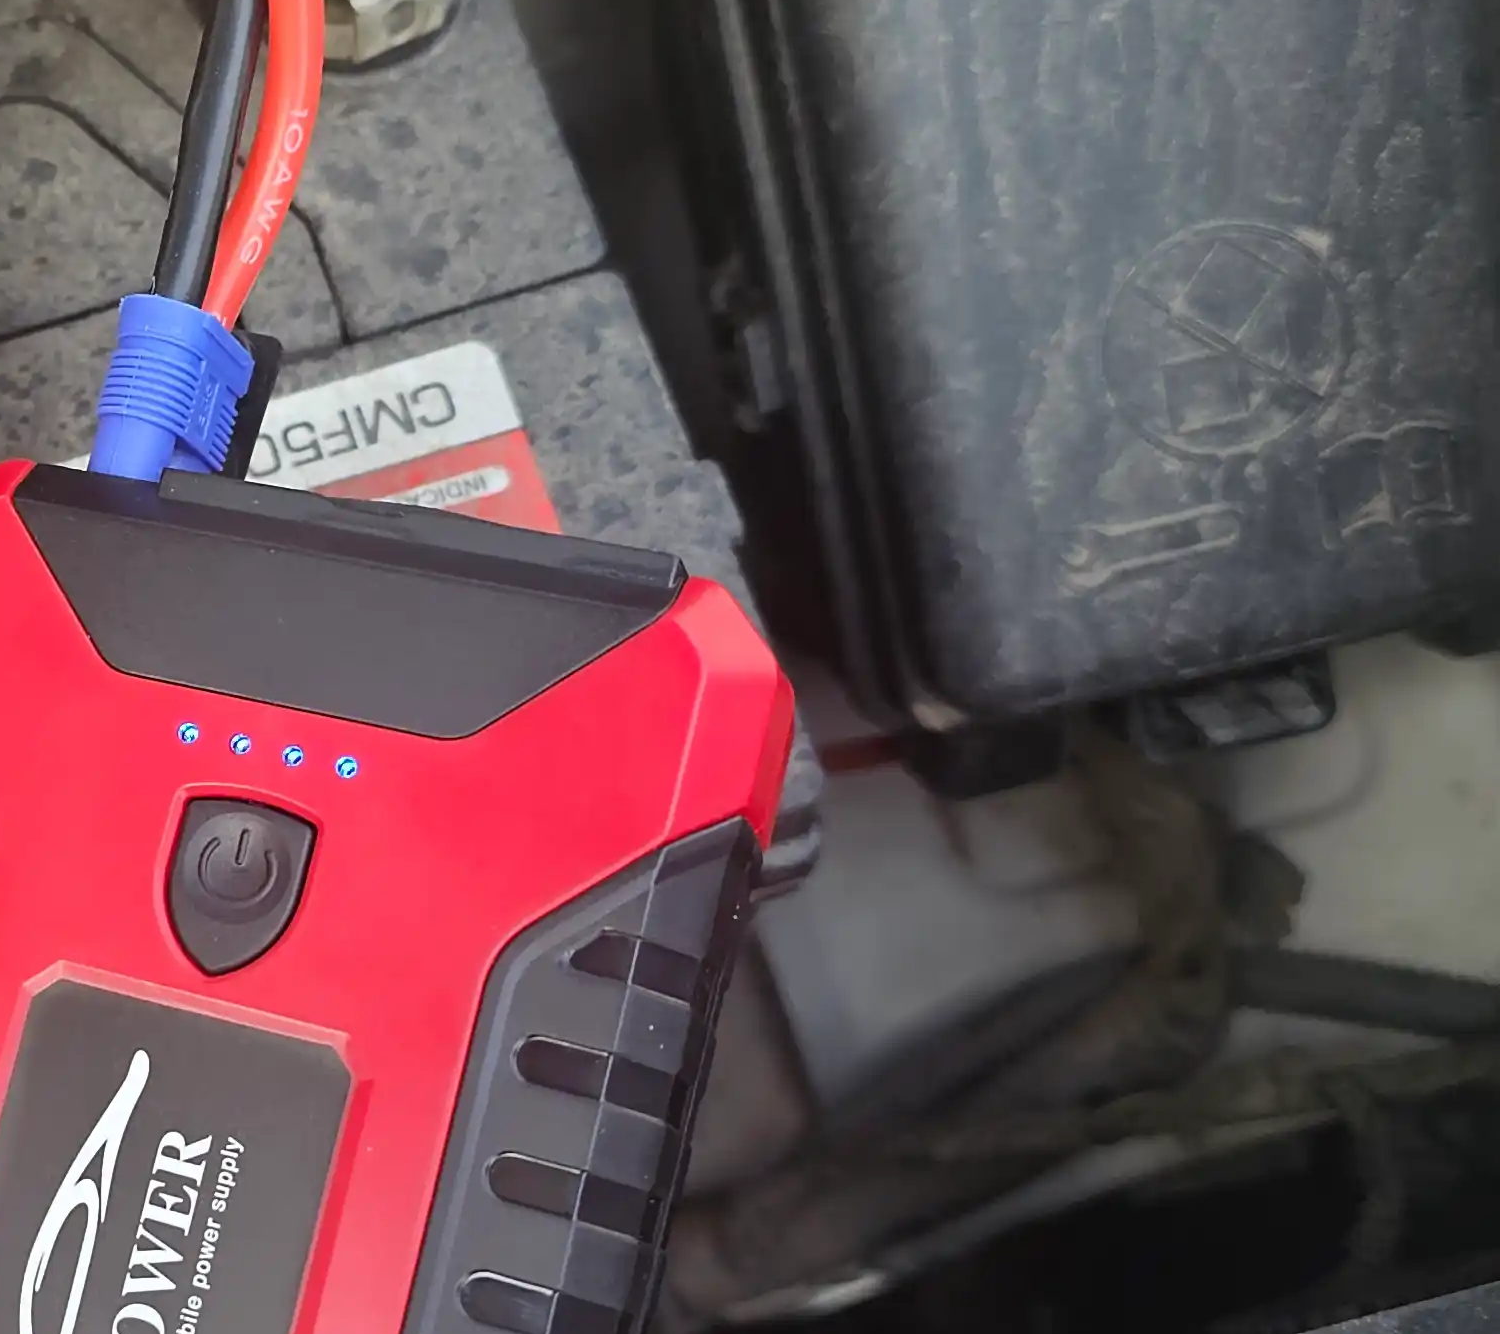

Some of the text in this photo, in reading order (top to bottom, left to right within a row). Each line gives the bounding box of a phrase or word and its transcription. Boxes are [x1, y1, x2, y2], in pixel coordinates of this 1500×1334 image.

[408, 474, 486, 505] INDICA
[191, 1216, 222, 1291] power
[211, 1136, 245, 1213] supply
